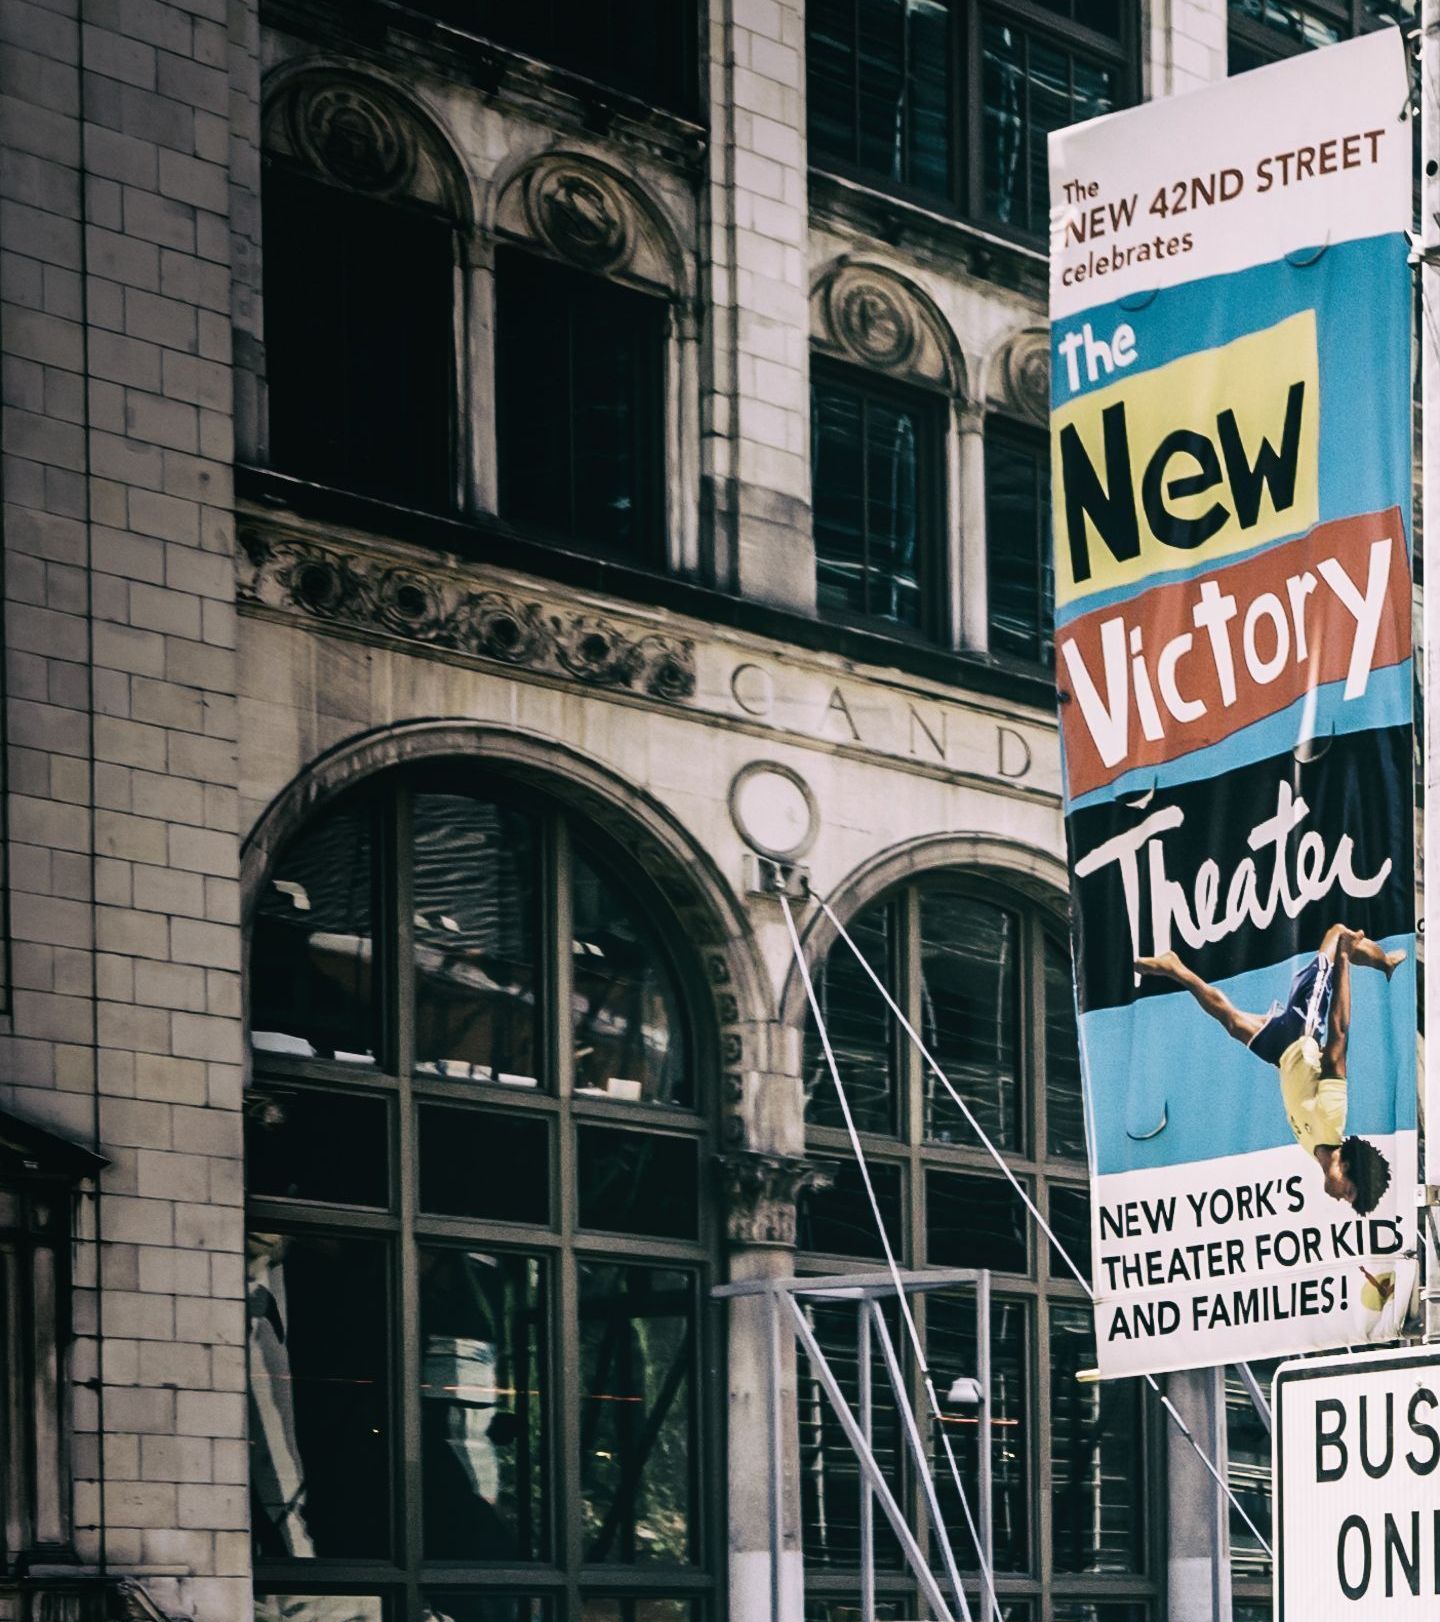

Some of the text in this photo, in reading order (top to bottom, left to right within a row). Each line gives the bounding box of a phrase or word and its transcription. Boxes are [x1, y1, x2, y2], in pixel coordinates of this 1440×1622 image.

[1063, 179, 1099, 202] The
[1064, 130, 1386, 248] NEW 42ND STREET
[1062, 229, 1194, 287] celebrates
[1058, 321, 1138, 393] The
[1060, 381, 1305, 583] New
[1061, 538, 1392, 768] Victory
[1074, 779, 1392, 987] Theater
[1099, 1176, 1304, 1241] NEW YORK'S
[1102, 1227, 1322, 1291] THEATER FOR
[1108, 1275, 1349, 1342] AND FAMILIES!
